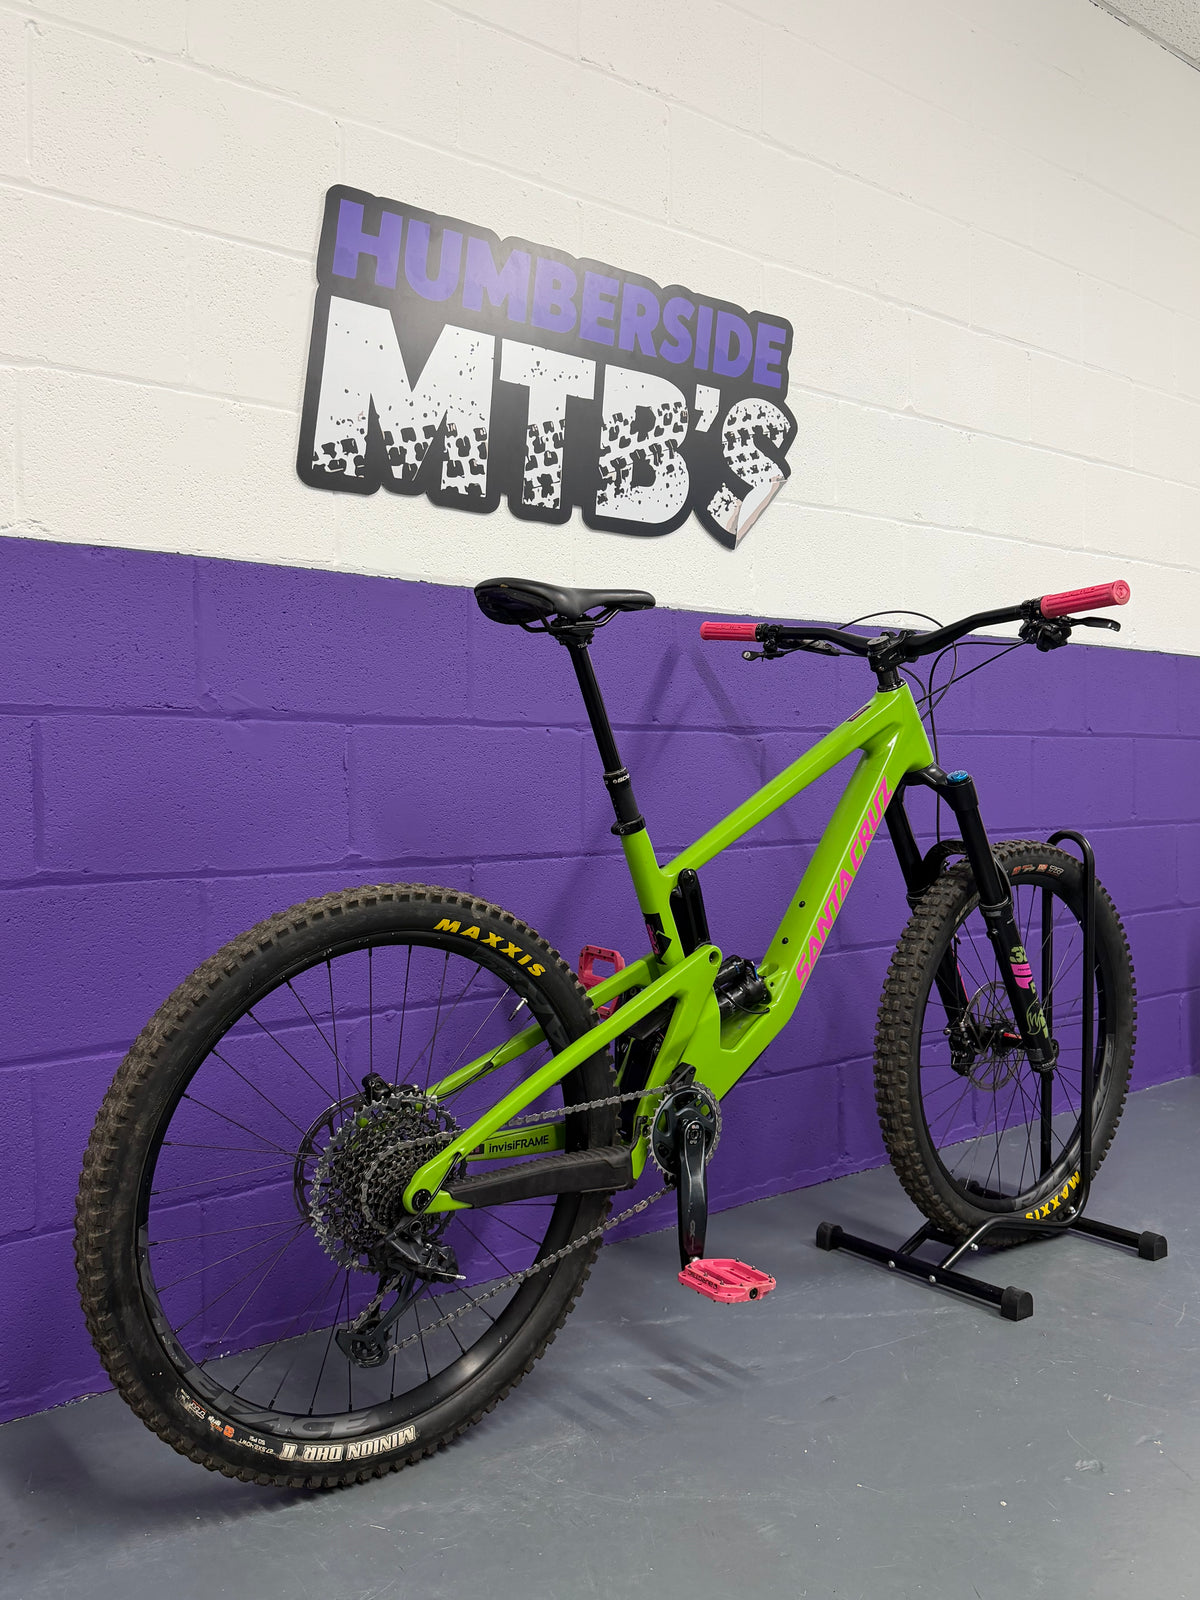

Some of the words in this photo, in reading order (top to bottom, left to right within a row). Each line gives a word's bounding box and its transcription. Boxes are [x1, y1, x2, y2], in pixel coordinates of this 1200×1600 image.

[332, 199, 786, 388] HUMBERSIDE
[796, 867, 853, 990] SANTA
[850, 775, 893, 872] CRUZ
[433, 918, 546, 977] MAXXIS
[489, 1134, 550, 1153] invisiFRAME
[302, 1444, 343, 1462] DHR
[346, 1425, 416, 1461] MINION
